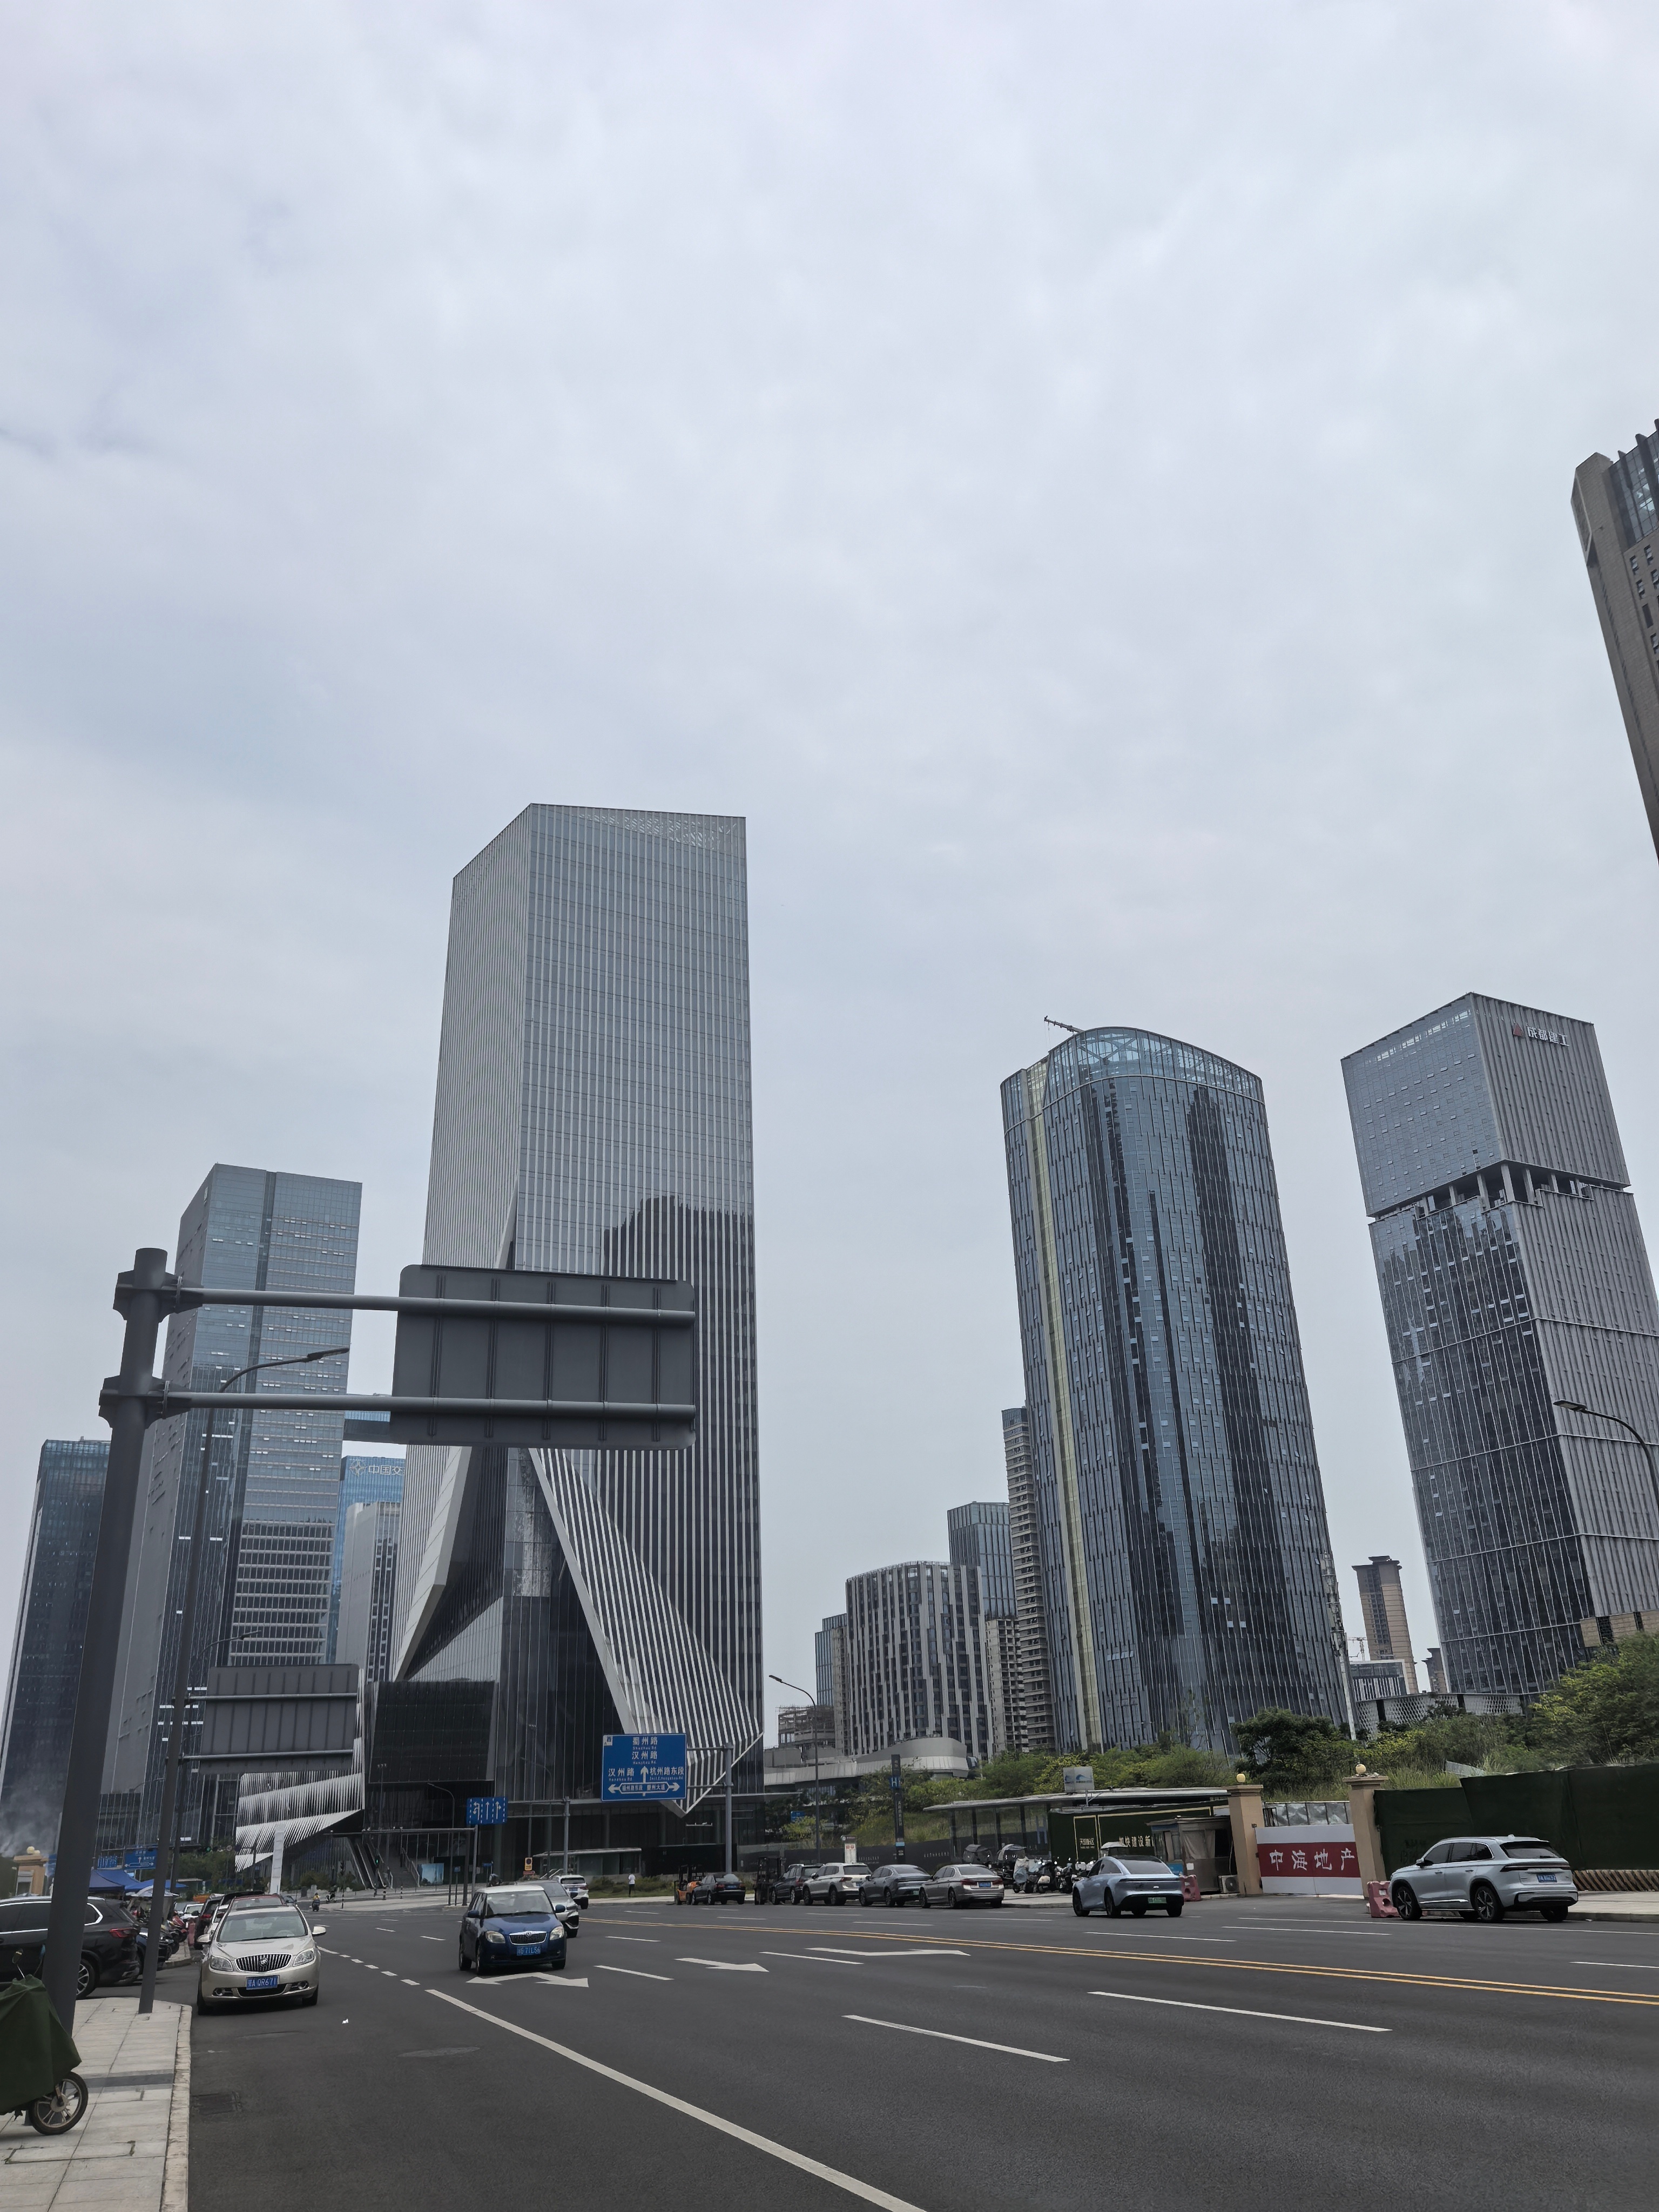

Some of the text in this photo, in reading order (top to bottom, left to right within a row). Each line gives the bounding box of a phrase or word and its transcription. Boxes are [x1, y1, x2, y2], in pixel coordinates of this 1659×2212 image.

[1527, 1026, 1569, 1047] 成都建工
[369, 1465, 404, 1475] 中国交
[633, 1736, 657, 1745] 蜀州路
[632, 1751, 657, 1759] 汉州路
[608, 1768, 634, 1776] 汉州路
[650, 1766, 684, 1776] 杭州路东段
[1119, 1835, 1154, 1847] 加快建设新
[1269, 1847, 1355, 1871] 中海地产
